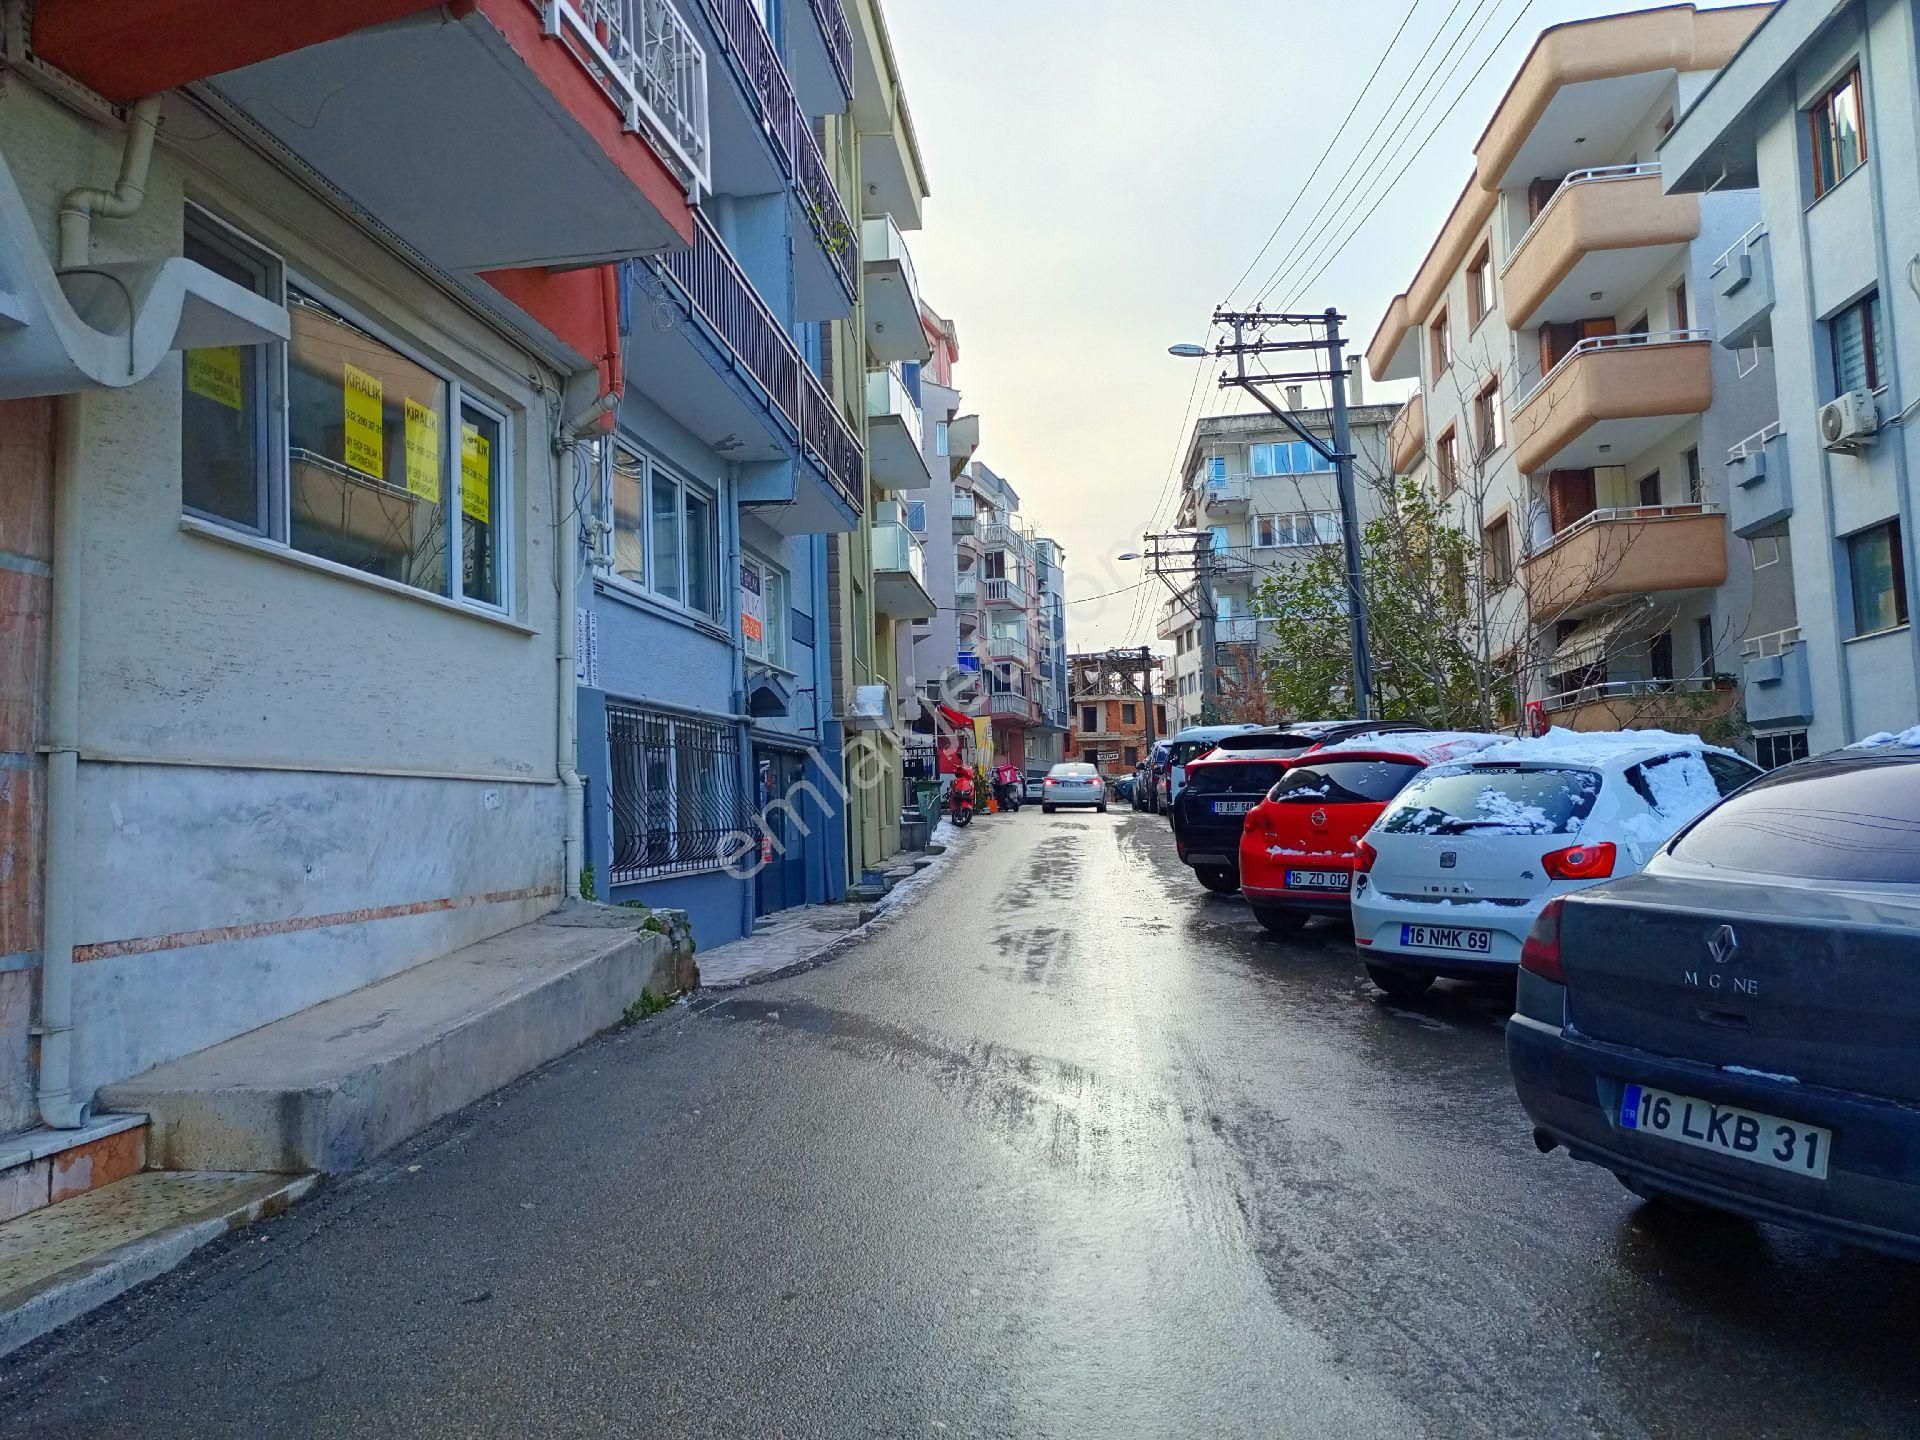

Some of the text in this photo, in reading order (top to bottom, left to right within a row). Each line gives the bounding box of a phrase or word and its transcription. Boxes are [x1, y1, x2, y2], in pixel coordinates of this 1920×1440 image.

[1215, 802, 1223, 812] 16
[1291, 872, 1348, 886] 16 ZD 012
[1409, 927, 1488, 949] 16 NMK 69
[1641, 1093, 1818, 1169] 16 LKB 31
